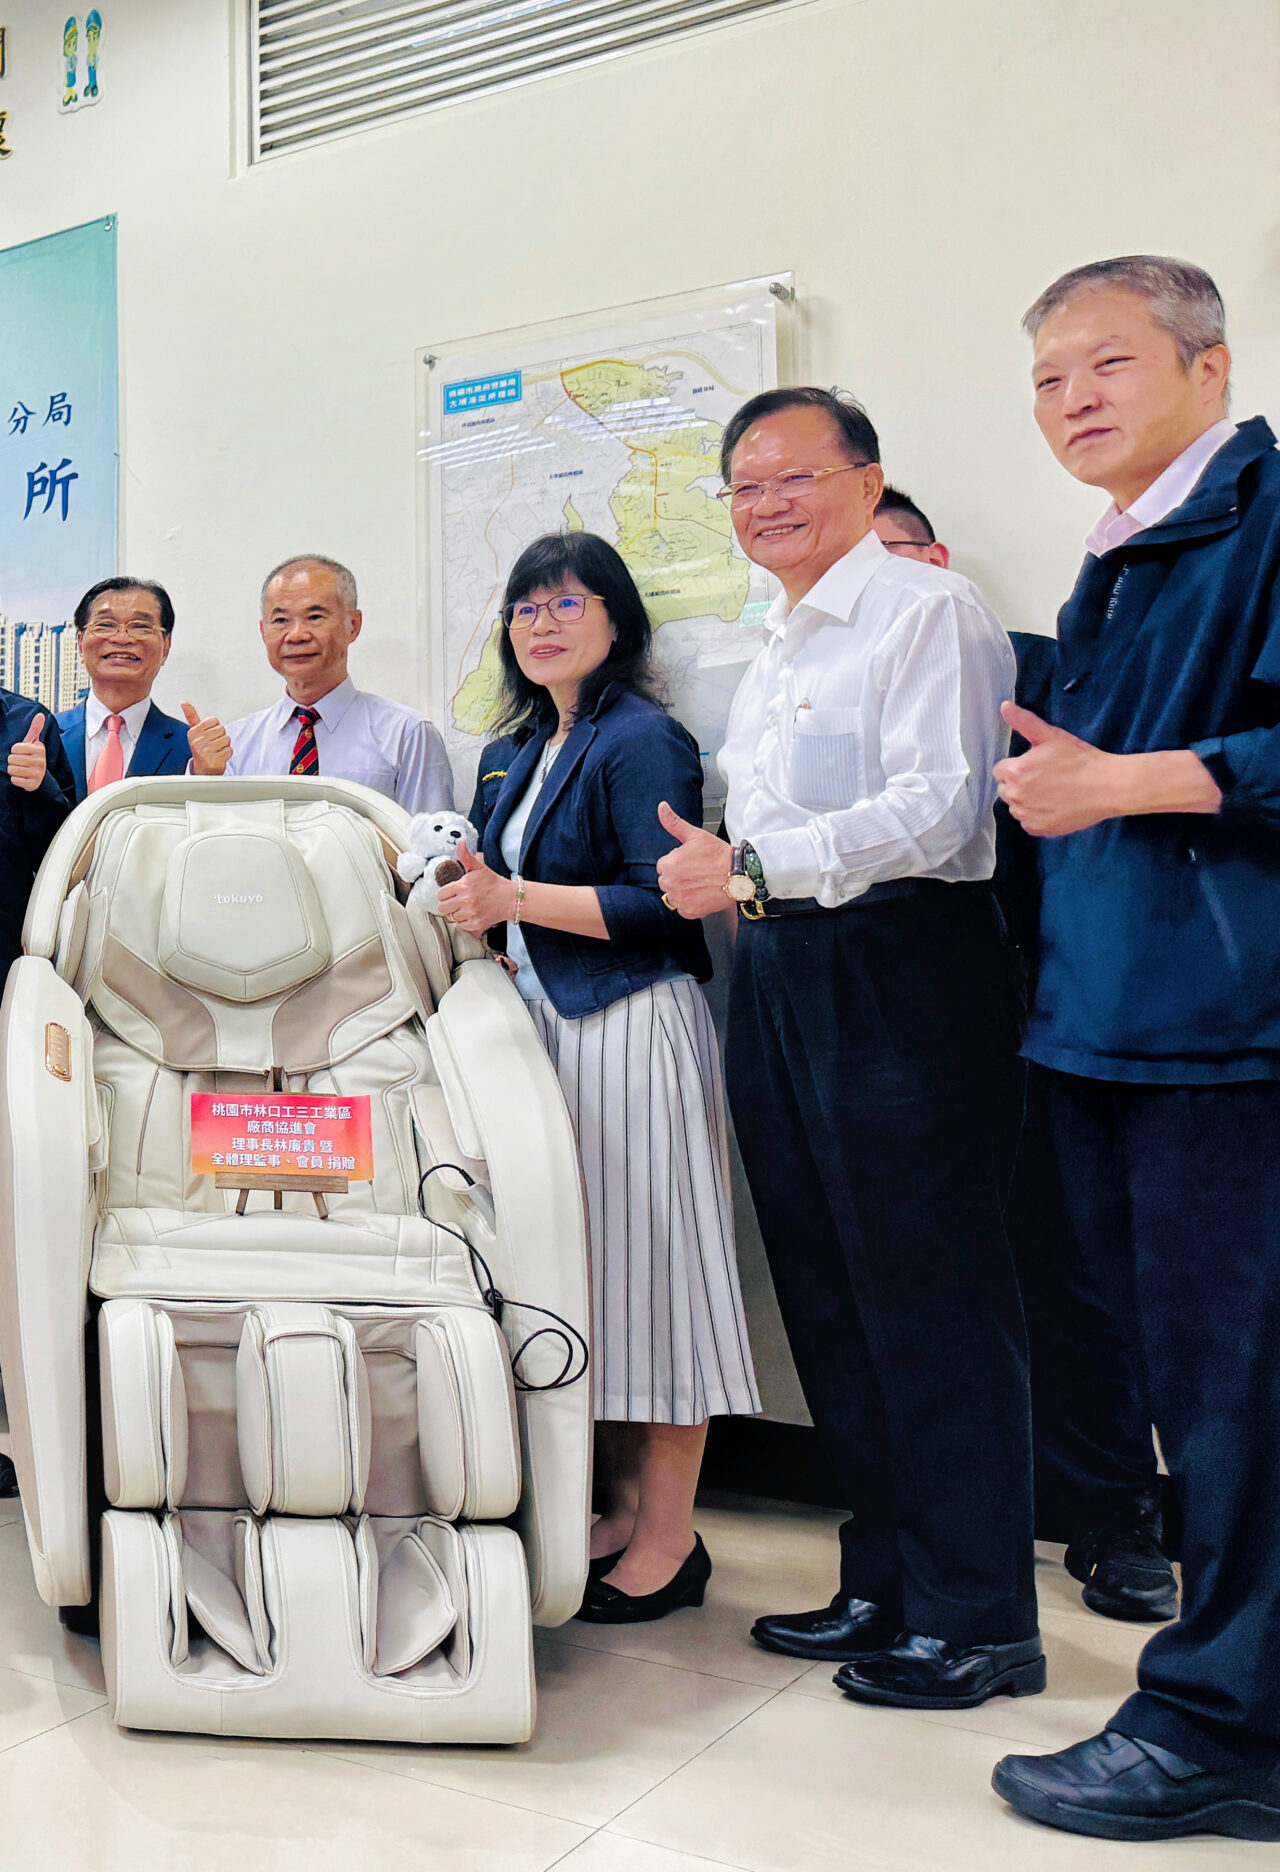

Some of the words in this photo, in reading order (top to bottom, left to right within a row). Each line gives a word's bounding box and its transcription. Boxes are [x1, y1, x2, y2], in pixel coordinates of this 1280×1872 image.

[217, 894, 263, 904] tokuyo
[212, 1103, 352, 1120] 桃園市林口工三工業區
[247, 1121, 317, 1135] 廠商協進會
[232, 1138, 316, 1153] 理事長林廉貴
[211, 1152, 323, 1169] 全體理監事、會員
[327, 1156, 355, 1170] 捐贈
